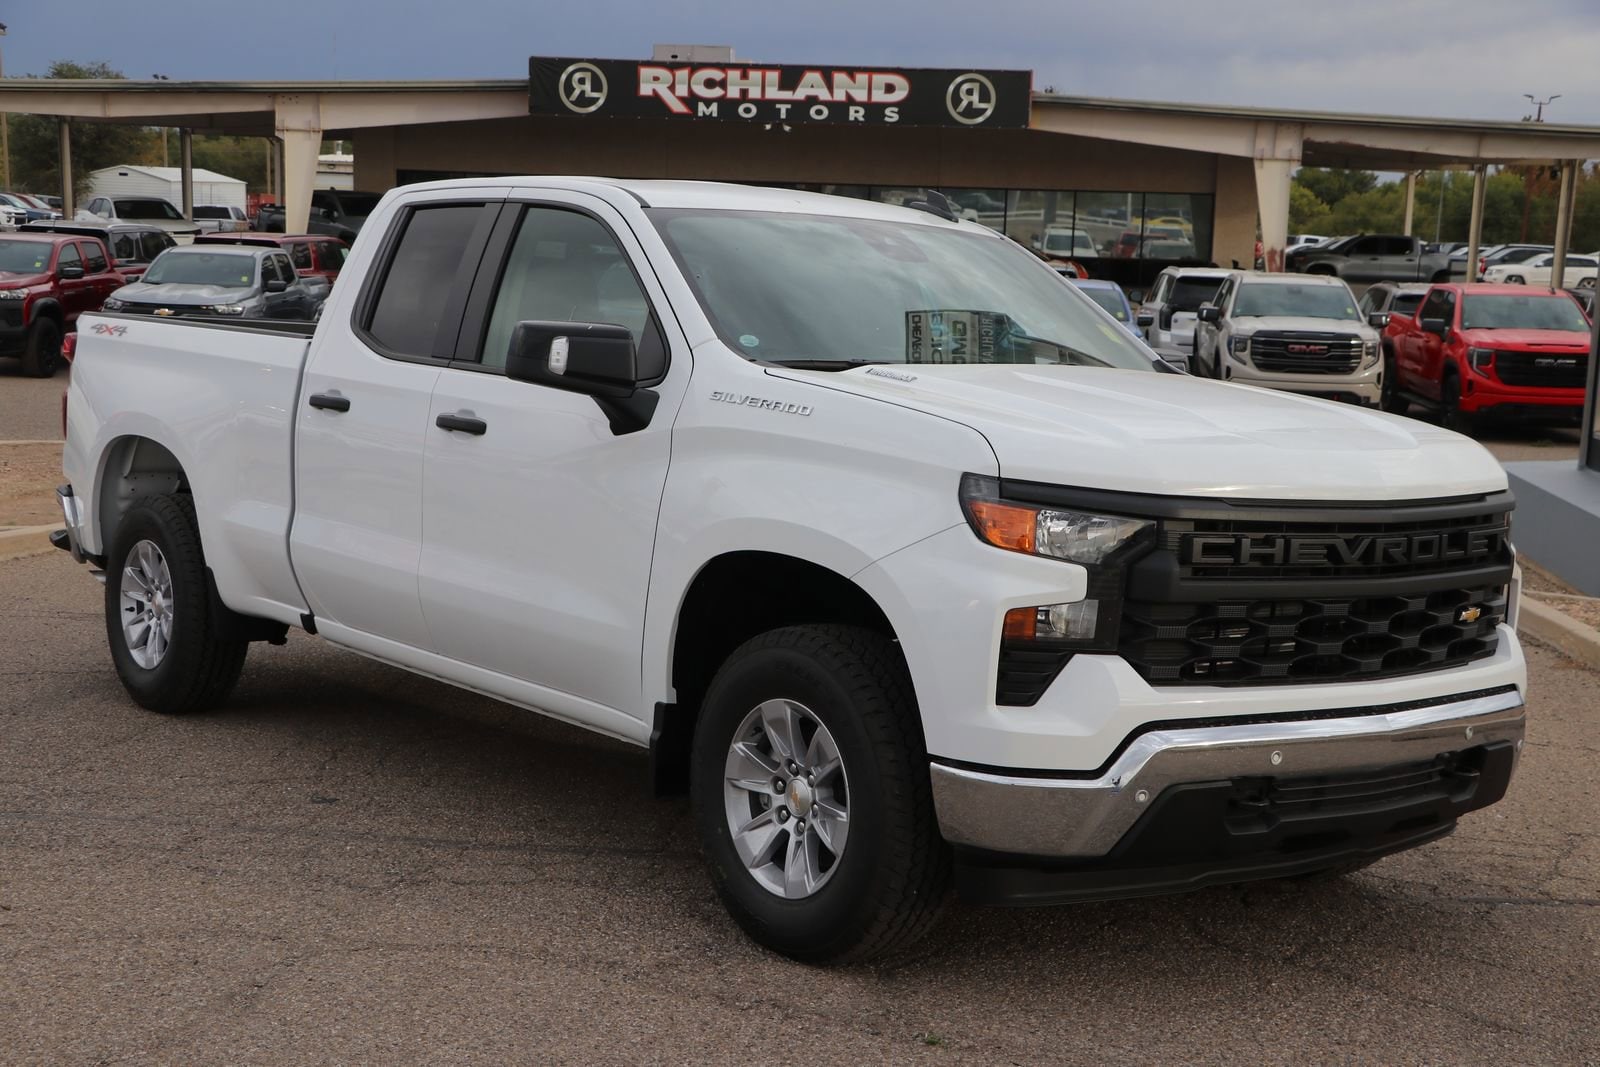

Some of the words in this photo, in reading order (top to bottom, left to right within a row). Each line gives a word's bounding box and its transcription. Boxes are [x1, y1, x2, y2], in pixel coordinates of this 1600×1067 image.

[638, 65, 911, 114] RICHLAND
[697, 101, 900, 123] MOTORS
[1288, 344, 1328, 354] GMC
[709, 391, 814, 416] SILVERADO
